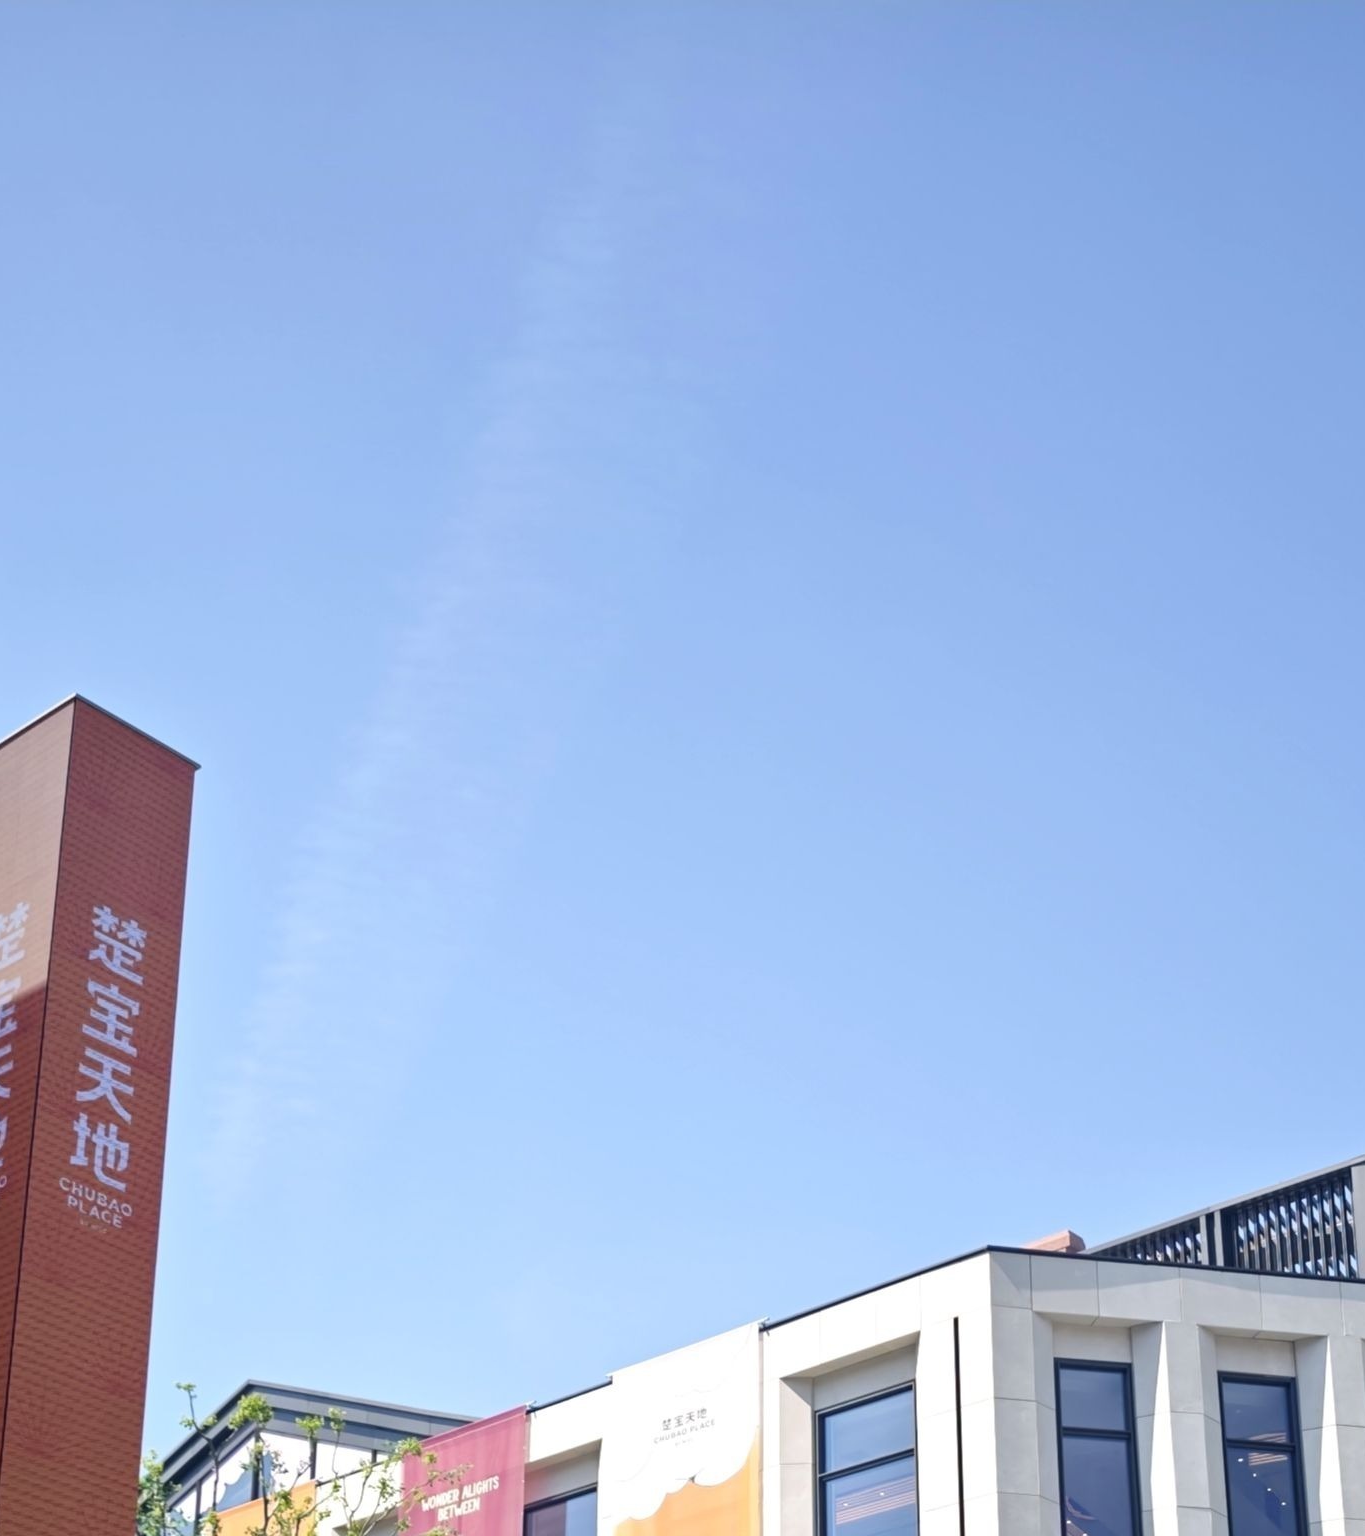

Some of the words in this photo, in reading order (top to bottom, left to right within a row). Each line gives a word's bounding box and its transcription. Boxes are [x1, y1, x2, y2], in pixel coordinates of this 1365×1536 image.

[69, 904, 148, 1193] 楚宝天地
[58, 1176, 133, 1217] CHUBAO
[67, 1195, 123, 1229] PLACE
[421, 1488, 460, 1513] WONDER
[461, 1475, 500, 1501] ALIGHTS
[437, 1496, 481, 1522] BETWEEN
